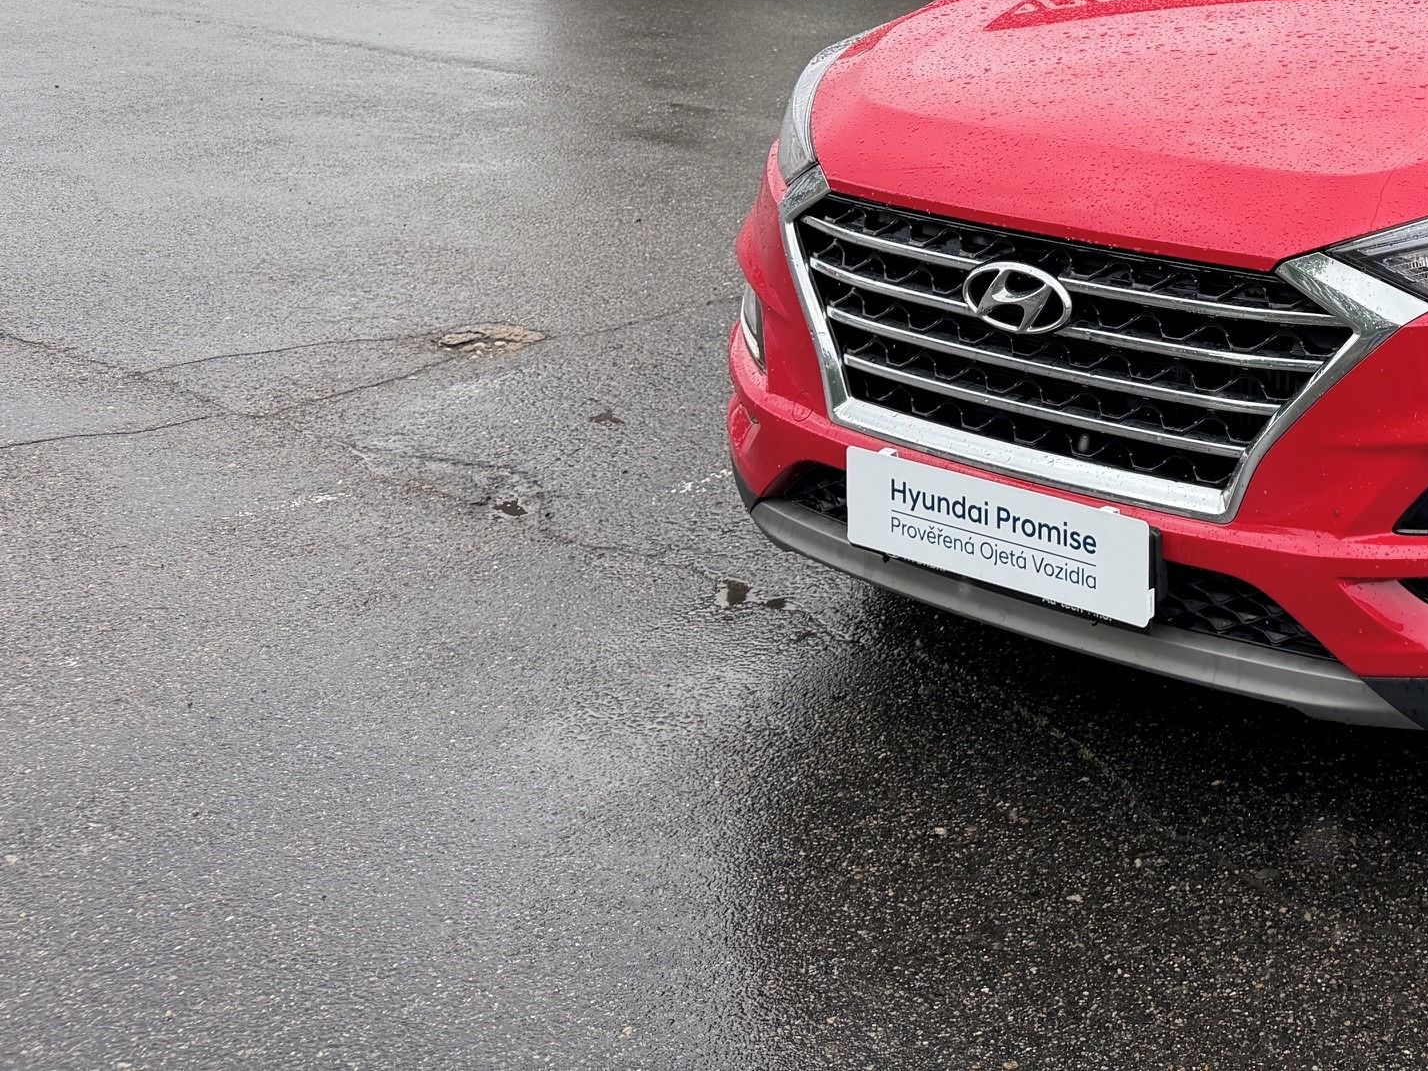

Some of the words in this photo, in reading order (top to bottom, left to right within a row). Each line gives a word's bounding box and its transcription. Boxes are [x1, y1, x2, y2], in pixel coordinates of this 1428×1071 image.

[890, 478, 989, 526] Hyundai
[996, 506, 1097, 556] Promise
[890, 516, 975, 556] Prověřená
[979, 540, 1027, 571] Ojetá
[1031, 554, 1097, 590] Vozidla
